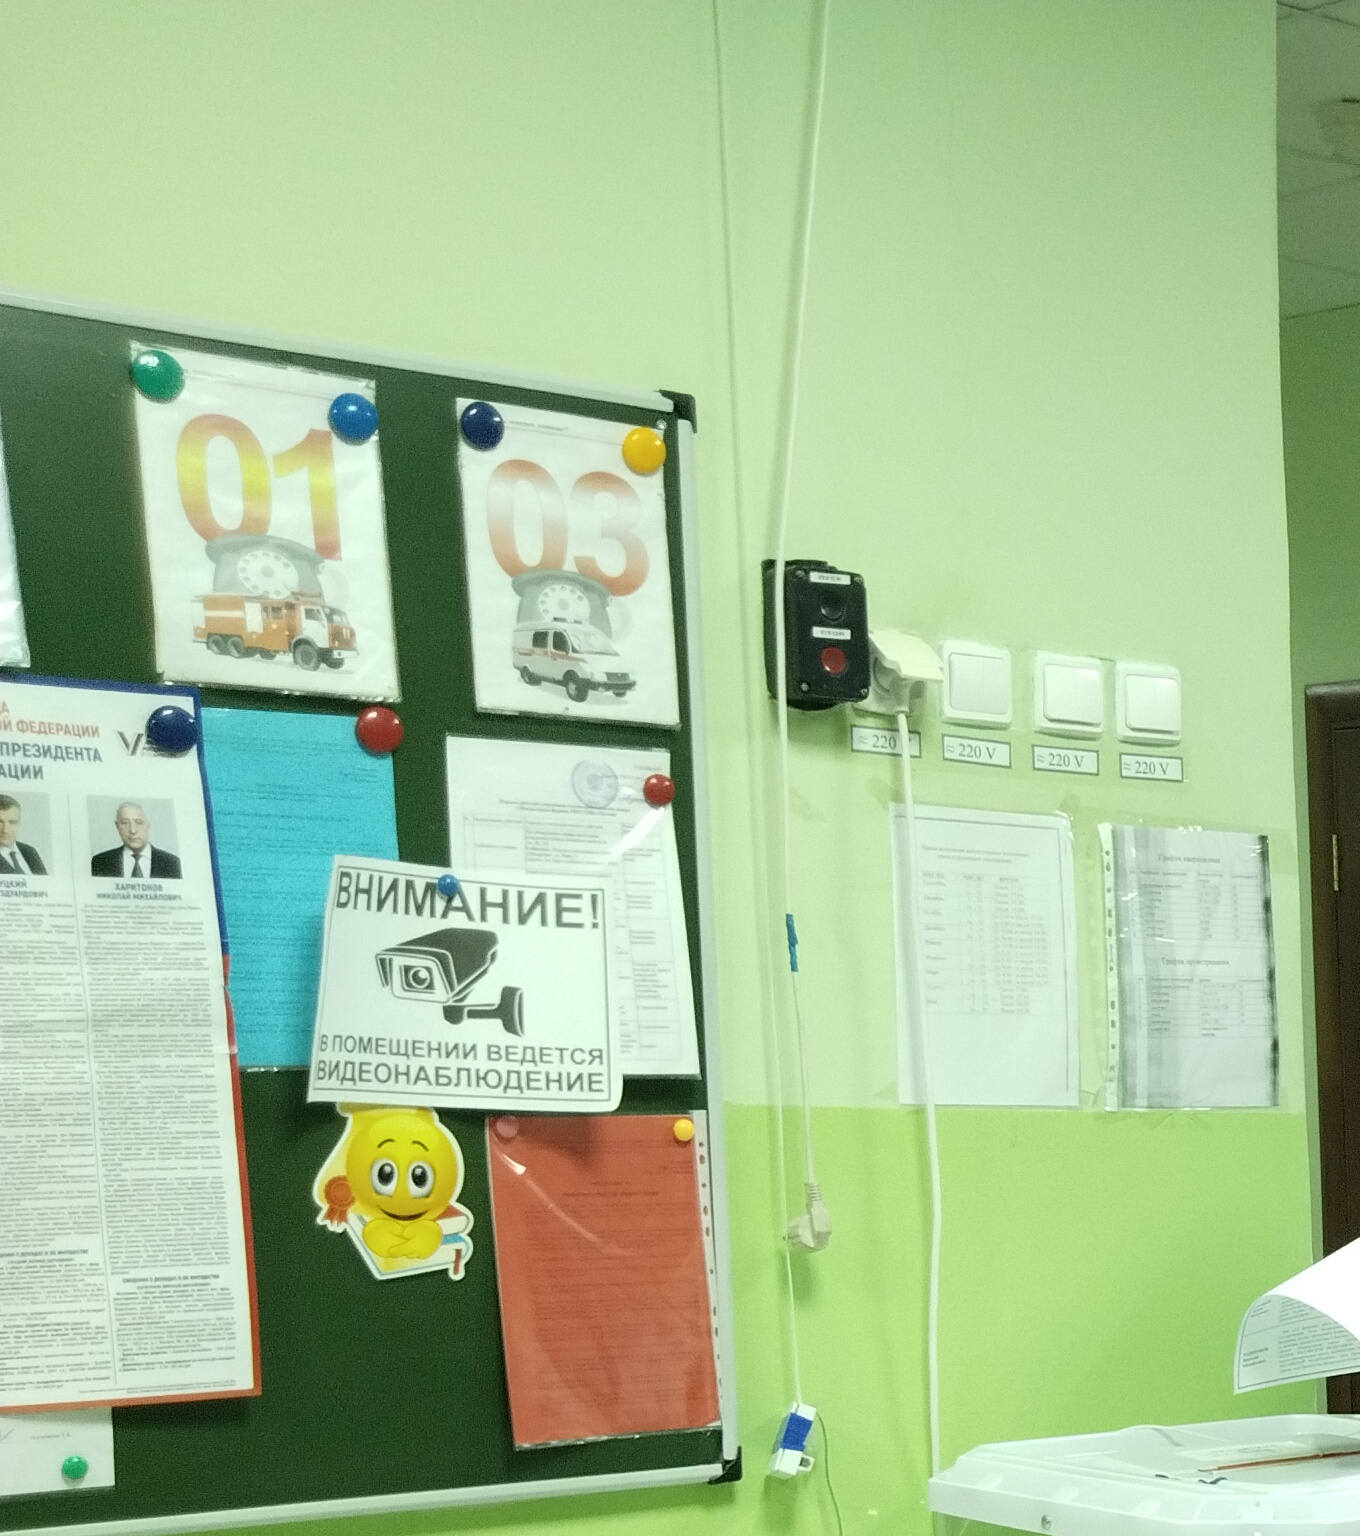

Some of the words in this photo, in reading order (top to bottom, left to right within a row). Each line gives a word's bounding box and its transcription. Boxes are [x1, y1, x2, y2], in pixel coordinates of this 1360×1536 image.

[177, 414, 342, 560] 01
[486, 459, 650, 597] 03
[16, 719, 100, 738] ФЕДЕРАЦИИ
[0, 741, 103, 762] ПРЕЗИДЕНТА
[958, 743, 982, 759] 220
[984, 747, 997, 760] V
[1048, 752, 1071, 768] 220
[1073, 755, 1084, 769] V
[1134, 760, 1157, 775] 220
[1158, 763, 1169, 776] V
[335, 871, 600, 930] ВНИМАНИЕ!
[320, 1034, 329, 1053] В
[333, 1035, 477, 1060] ПОМЕЩЕНИИ
[487, 1044, 604, 1066] ВЕДЕТСЯ
[317, 1060, 604, 1093] ВИДЕОНАБЛЮДЕНИЕ
